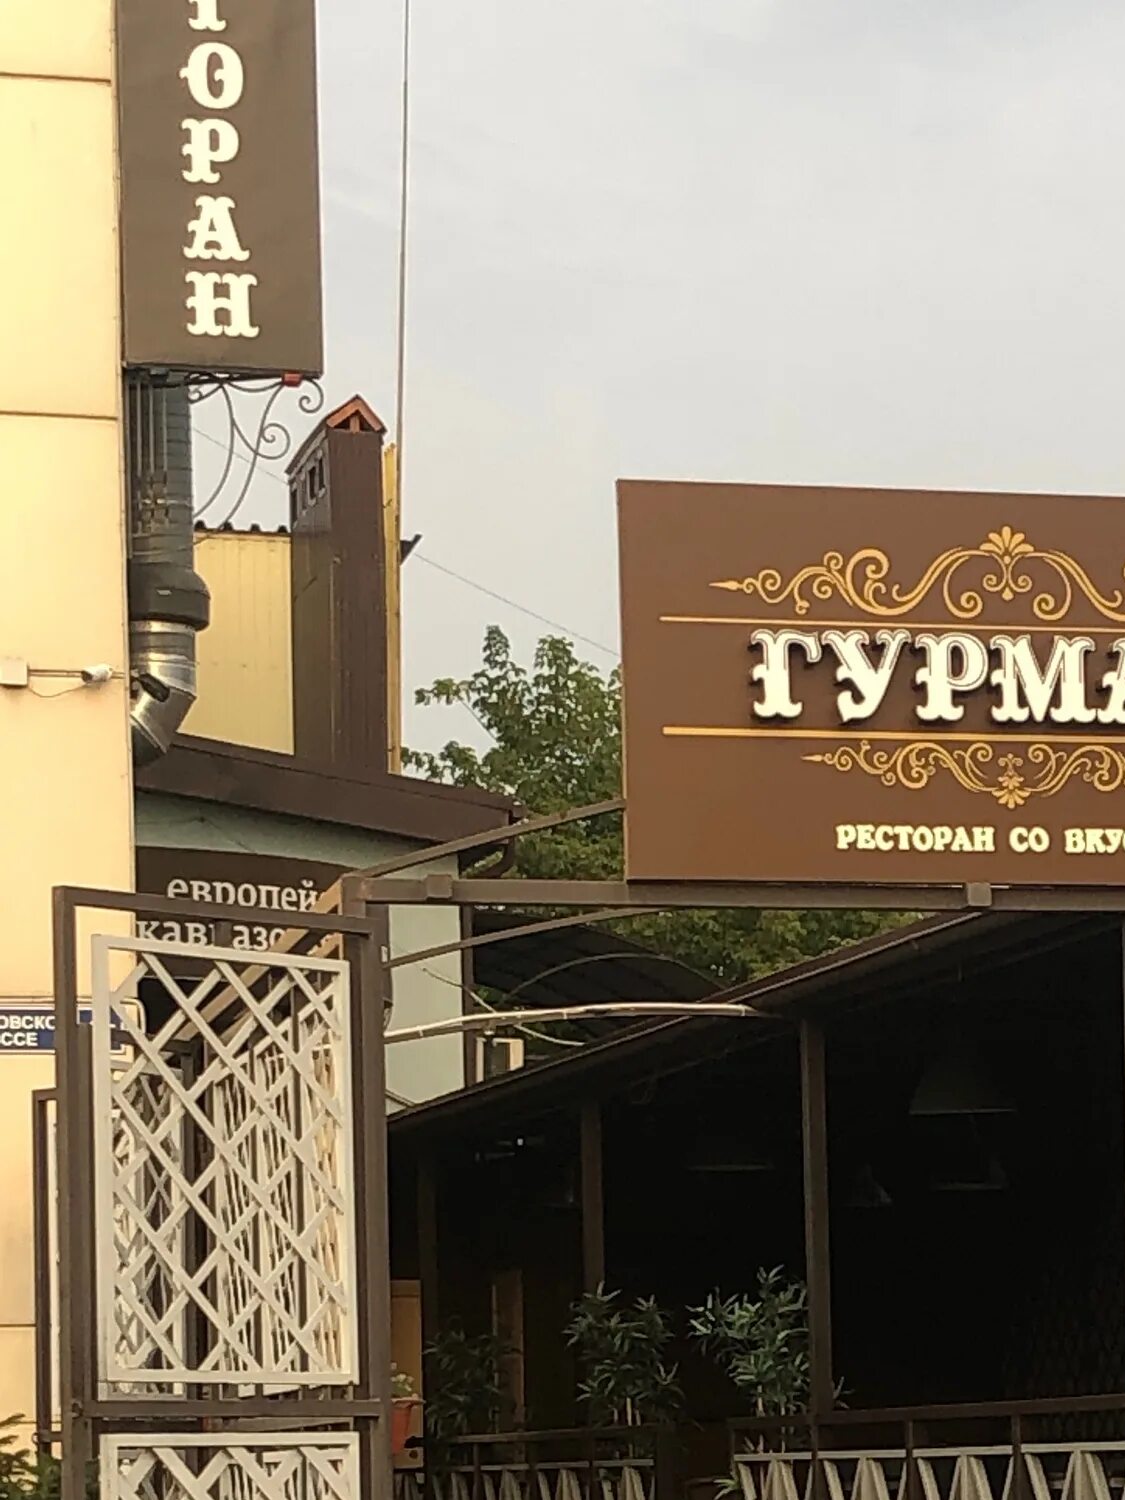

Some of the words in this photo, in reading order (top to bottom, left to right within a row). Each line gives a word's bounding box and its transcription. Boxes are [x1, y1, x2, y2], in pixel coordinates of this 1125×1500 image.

[835, 824, 995, 853] РЕСТОРАН
[1008, 826, 1050, 853] СО
[167, 878, 324, 912] европей
[0, 1032, 39, 1047] ССЕ
